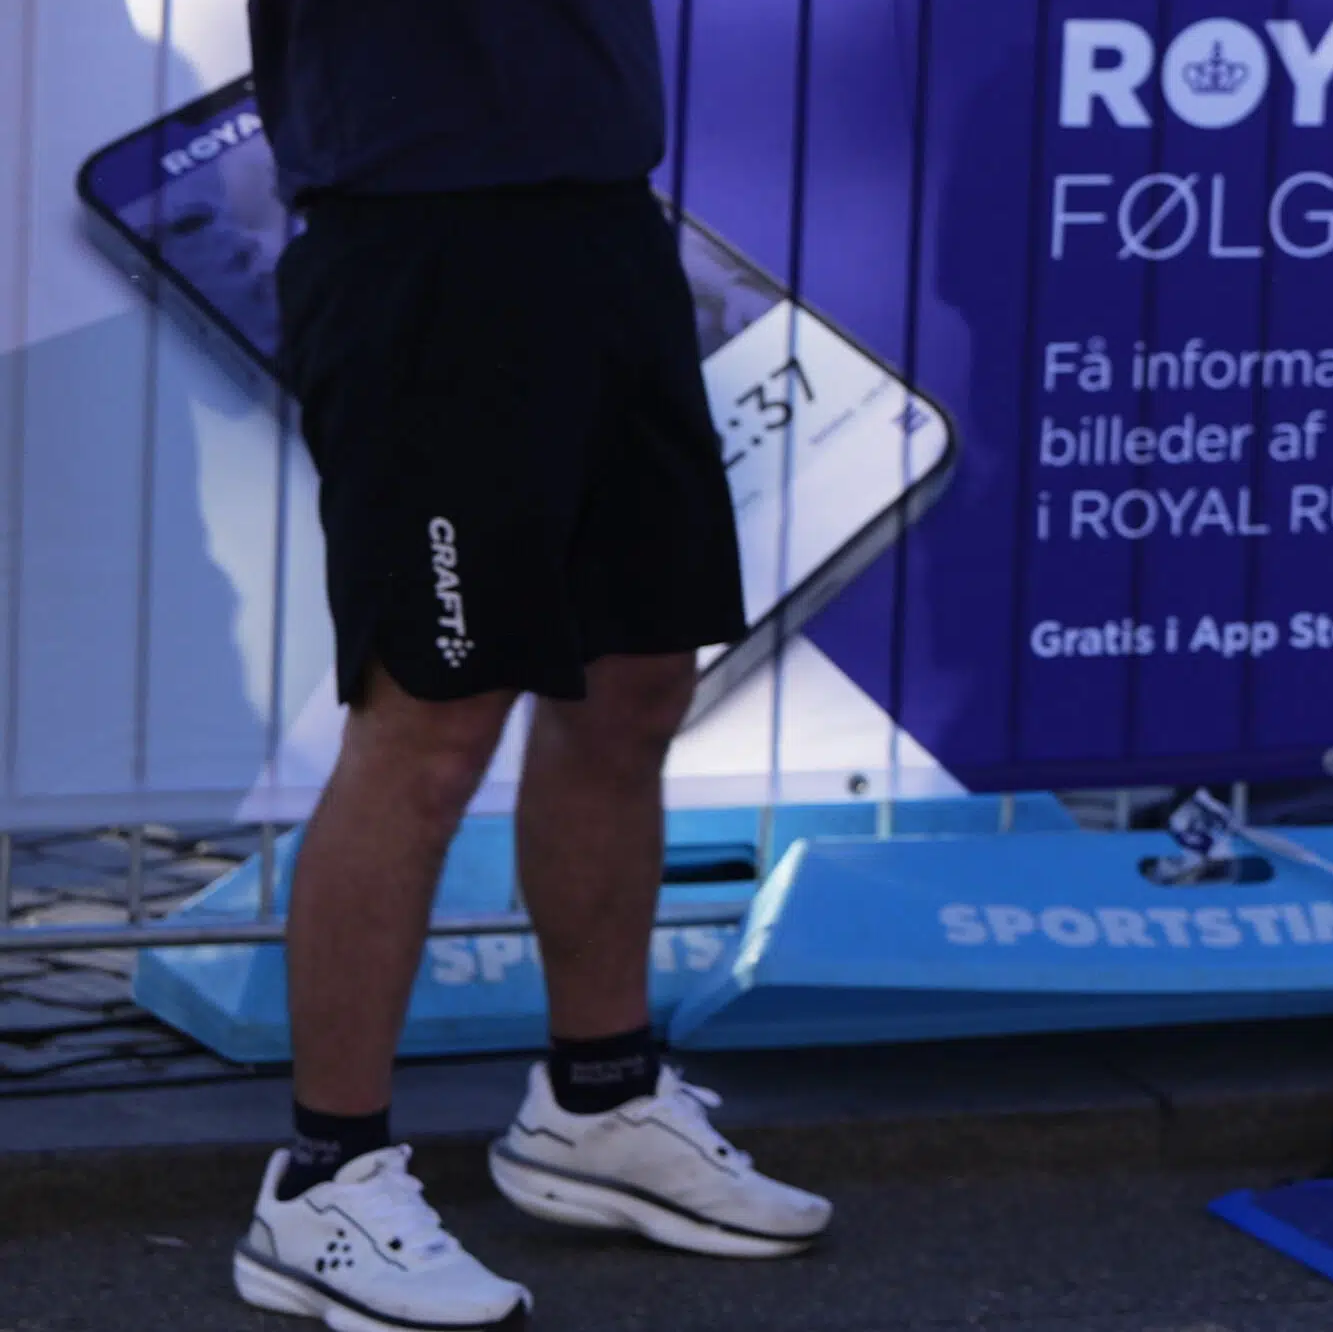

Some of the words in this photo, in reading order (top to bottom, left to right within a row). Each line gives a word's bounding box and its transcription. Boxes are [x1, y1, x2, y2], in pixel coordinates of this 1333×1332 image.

[1043, 335, 1113, 393] Få
[1038, 413, 1254, 468] billeder
[1267, 408, 1327, 462] af
[1036, 490, 1051, 541] i
[1069, 486, 1271, 540] ROYAL
[428, 517, 466, 637] CRAFT
[1029, 616, 1156, 658] Gratis
[1164, 616, 1179, 654] i
[1189, 614, 1280, 658] App
